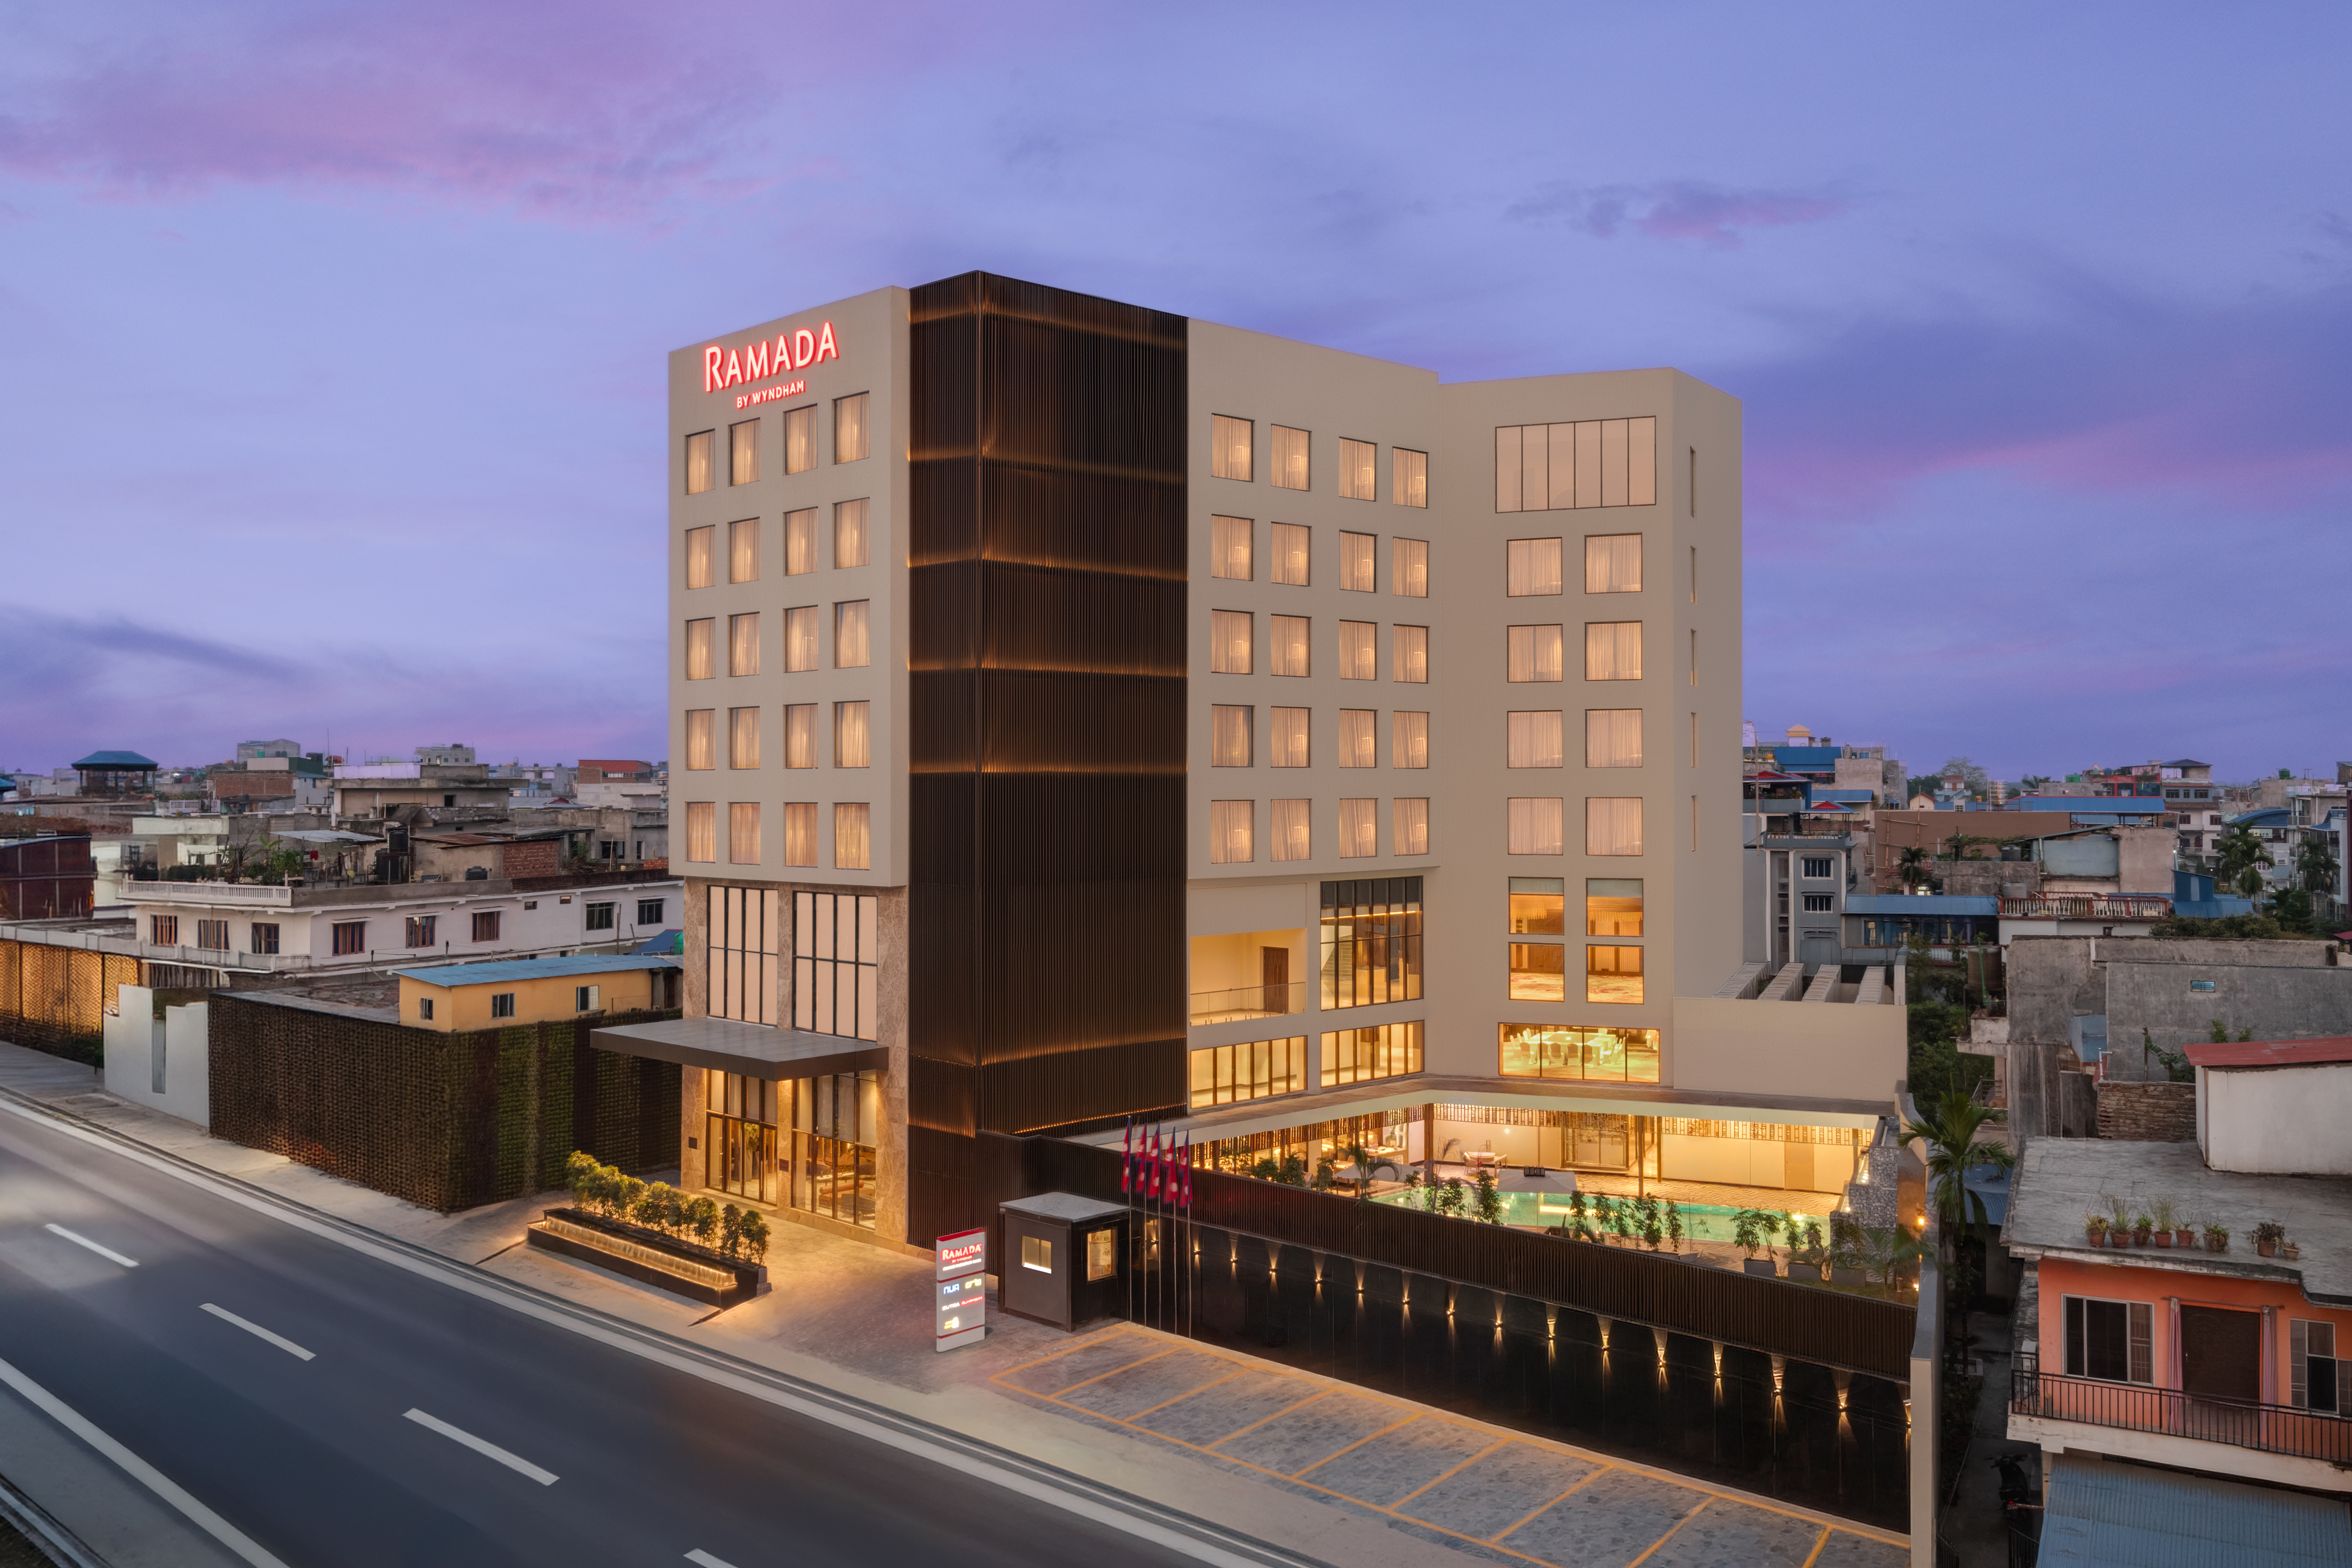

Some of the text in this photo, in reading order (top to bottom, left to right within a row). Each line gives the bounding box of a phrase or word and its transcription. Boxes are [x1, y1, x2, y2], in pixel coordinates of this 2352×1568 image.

[705, 322, 839, 392] RAMADA
[736, 381, 806, 409] BY WYNDHAM
[942, 1244, 980, 1261] RAMADA
